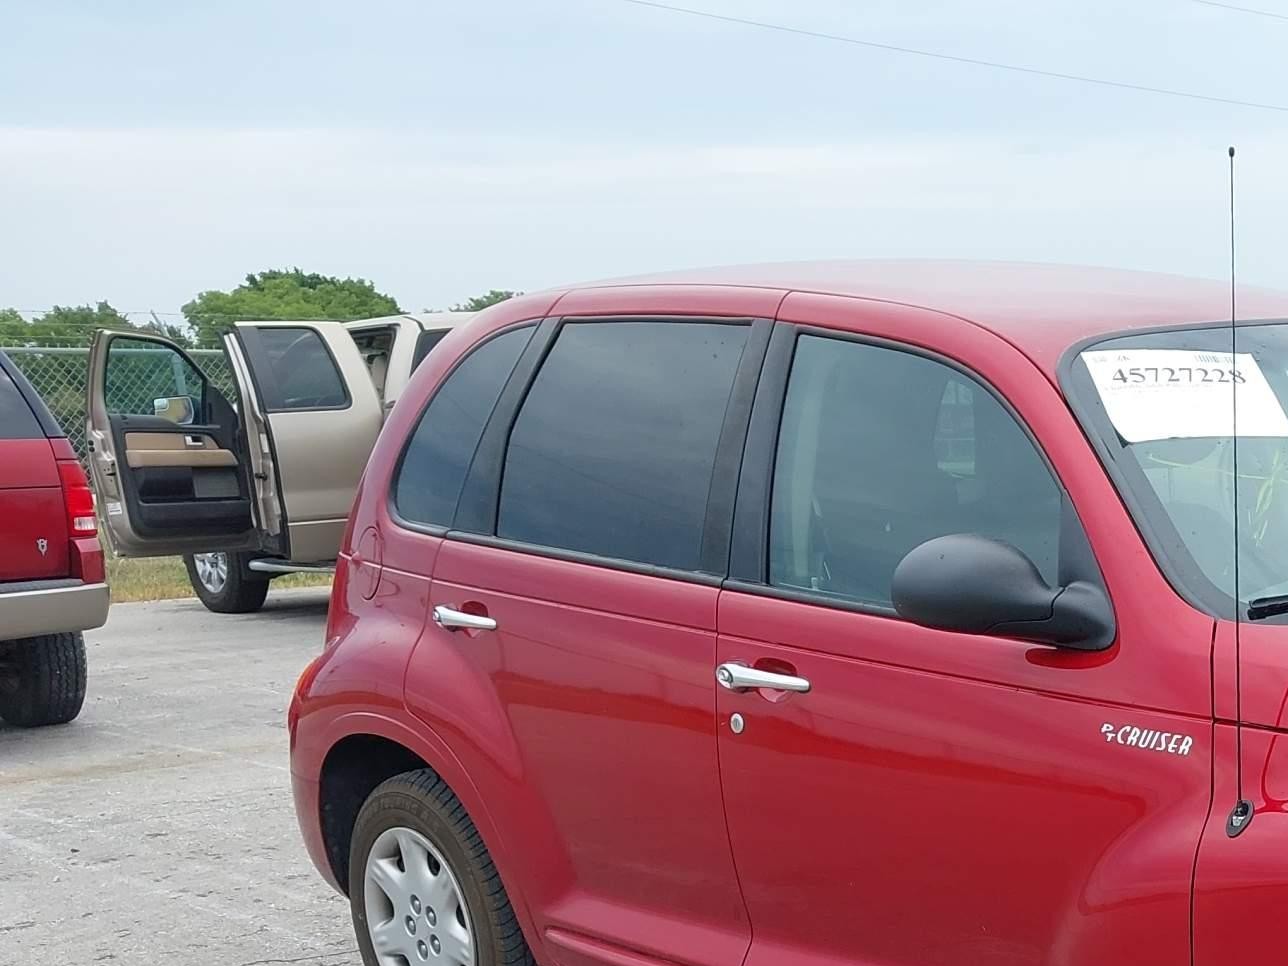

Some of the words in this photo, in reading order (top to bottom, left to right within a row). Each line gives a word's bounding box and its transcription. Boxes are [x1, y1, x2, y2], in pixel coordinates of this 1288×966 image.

[1112, 367, 1247, 384] 45727228
[1100, 723, 1116, 742] PT
[1116, 725, 1193, 756] CRUISER
